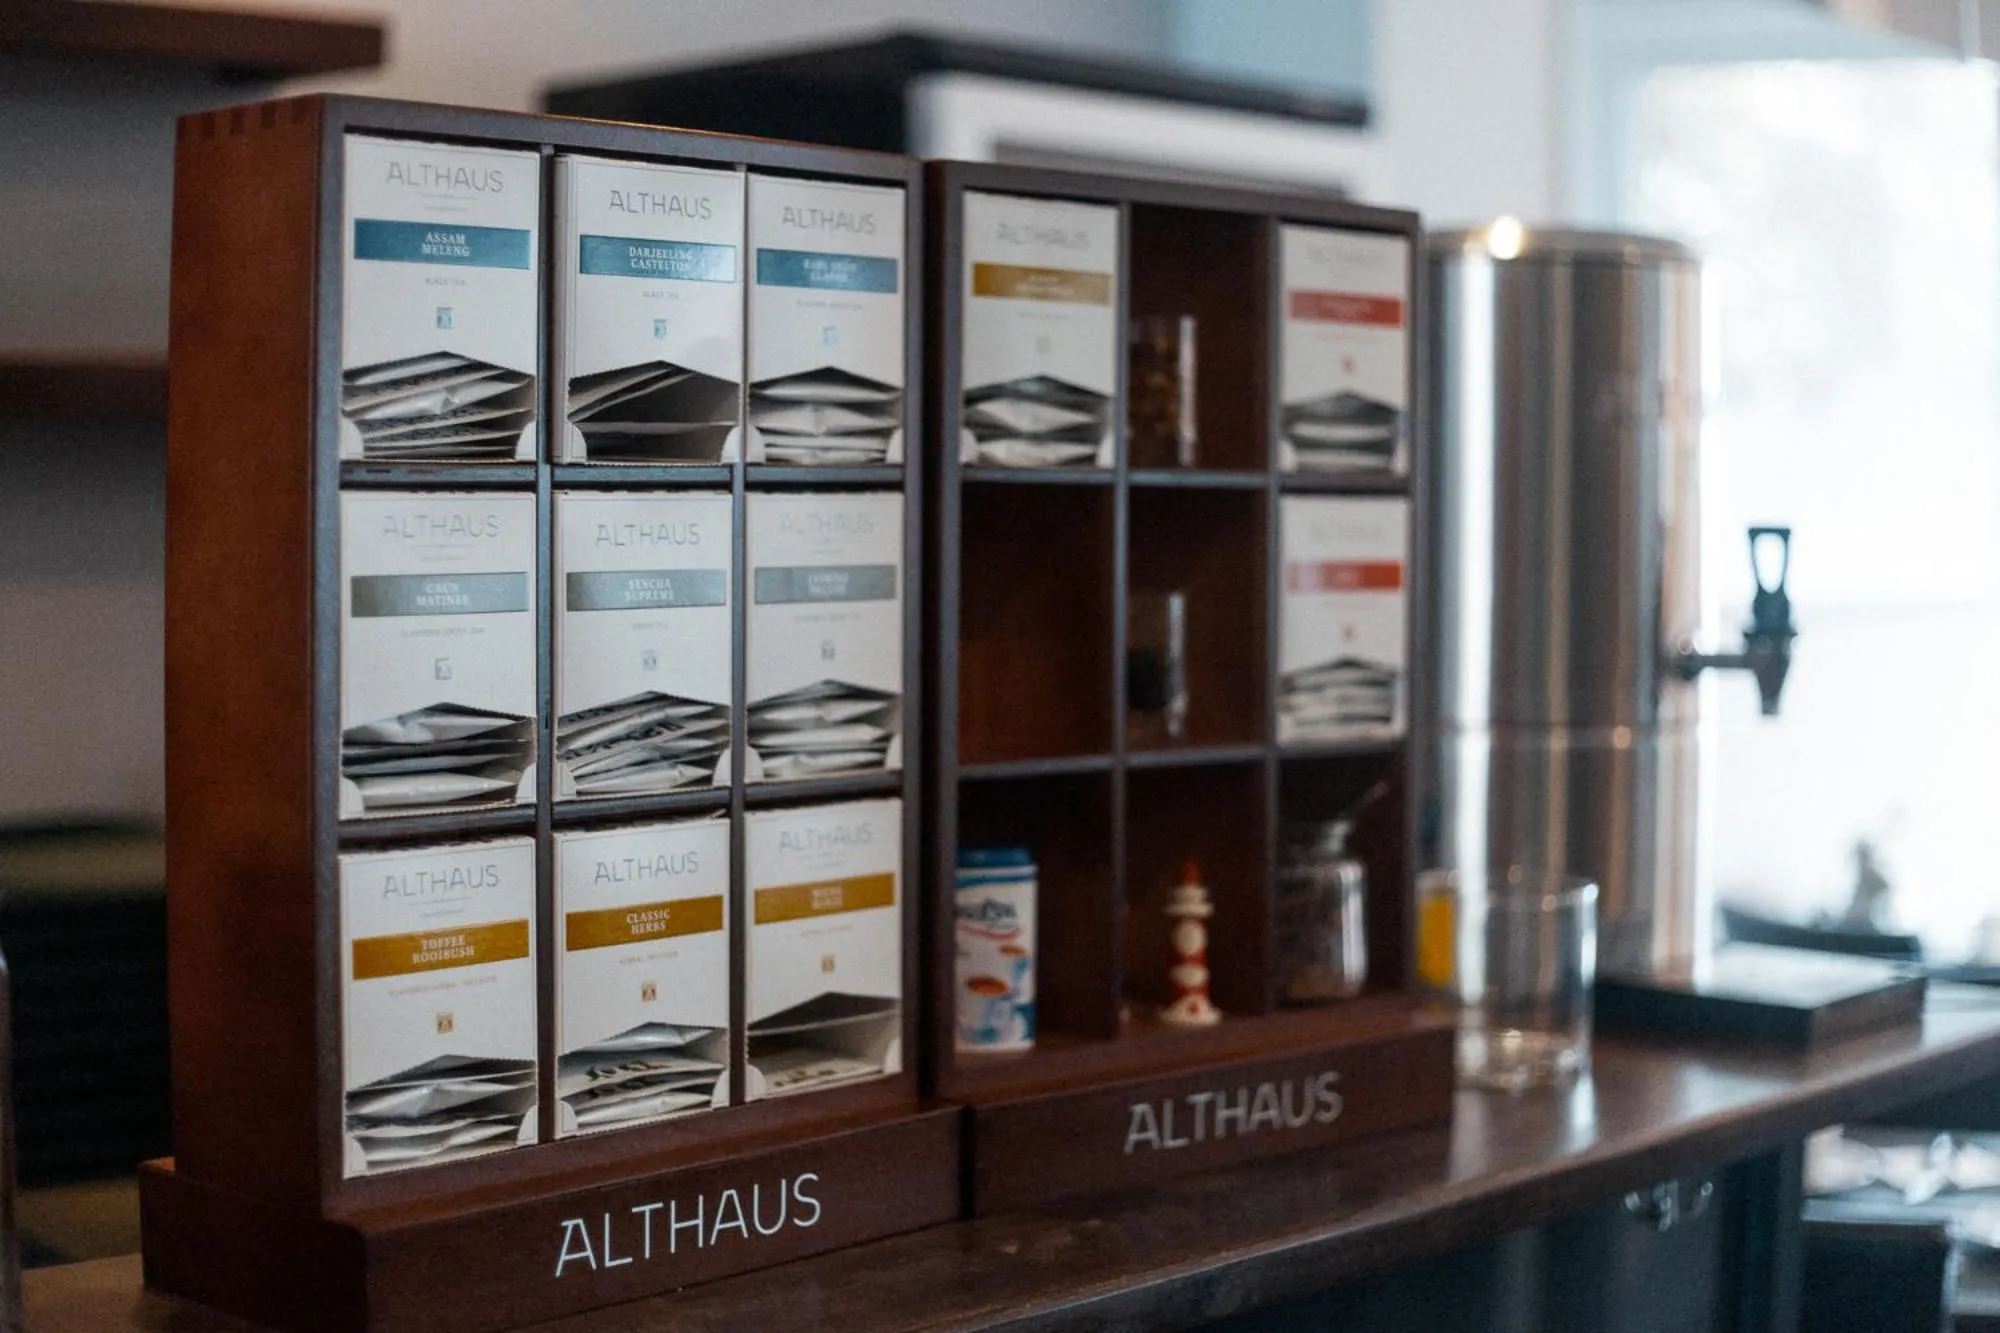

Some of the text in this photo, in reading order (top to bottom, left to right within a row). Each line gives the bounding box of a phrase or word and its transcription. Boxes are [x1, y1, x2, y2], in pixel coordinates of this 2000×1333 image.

[386, 161, 504, 193] ALTHAUS
[608, 189, 713, 220] ALTHAUS
[782, 206, 876, 235] ALTHAUS
[424, 232, 467, 245] ASSAM
[383, 514, 501, 538] ALTHAUS
[595, 523, 701, 547] ALTHAUS
[779, 822, 874, 852] ALTHAUS
[383, 864, 500, 899] ALTHAUS
[594, 851, 699, 886] ALTHAUS
[626, 908, 671, 924] CLASSIC
[422, 934, 468, 950] TOFFEE
[1123, 1070, 1344, 1155] ALTHAUS
[555, 1173, 821, 1278] ALTHAUS
